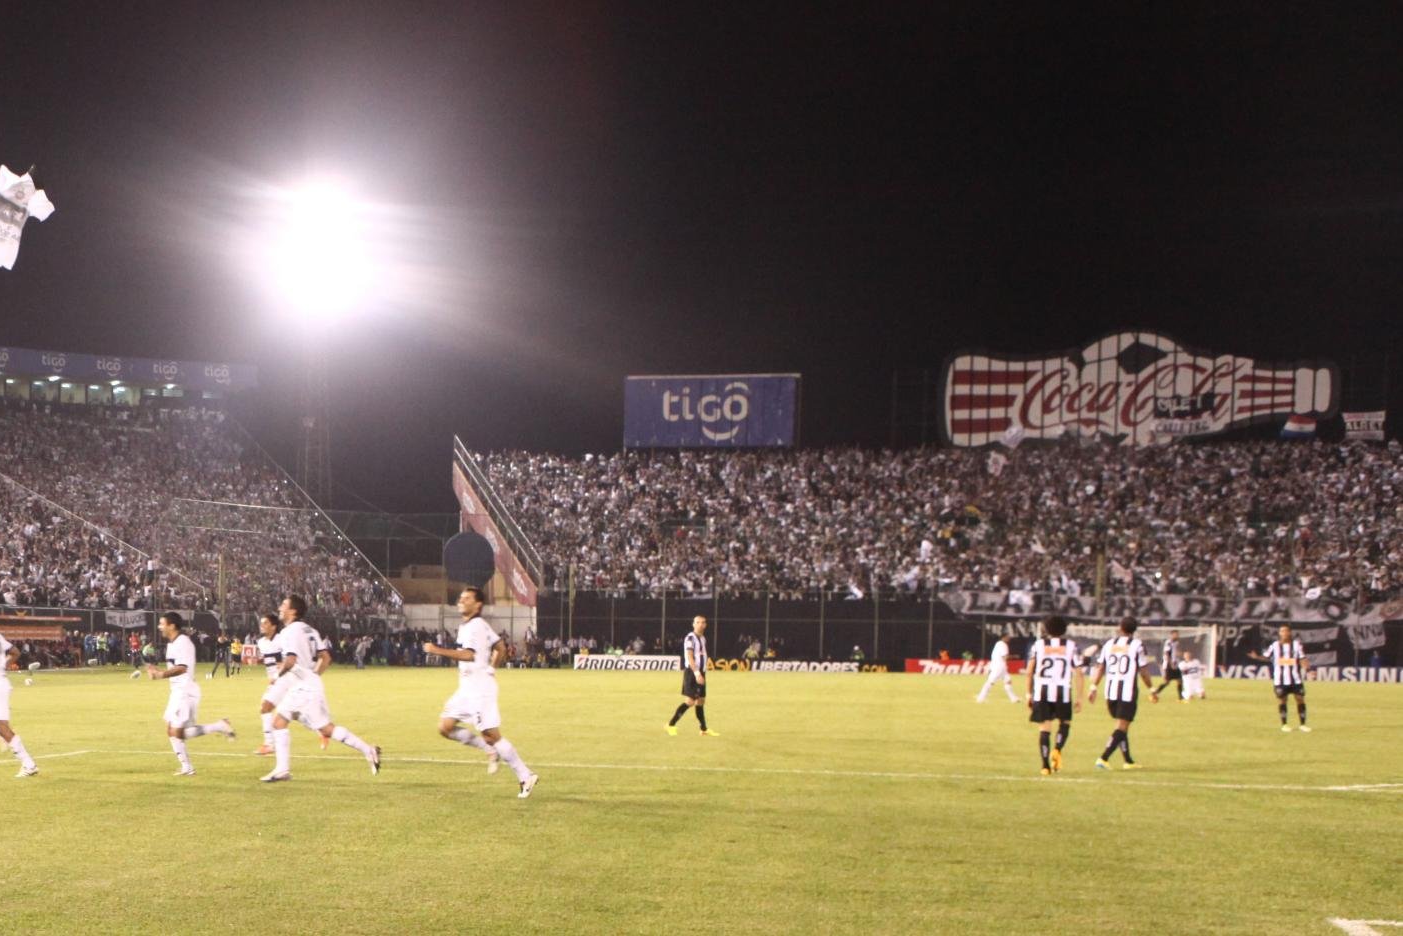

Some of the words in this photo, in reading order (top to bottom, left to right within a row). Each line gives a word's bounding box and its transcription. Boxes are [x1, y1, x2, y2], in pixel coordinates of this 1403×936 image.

[577, 658, 678, 671] BRIDGESTONE
[706, 657, 750, 672] ASION
[1039, 657, 1067, 679] 27
[1108, 654, 1131, 675] 20
[1219, 665, 1271, 680] VISA
